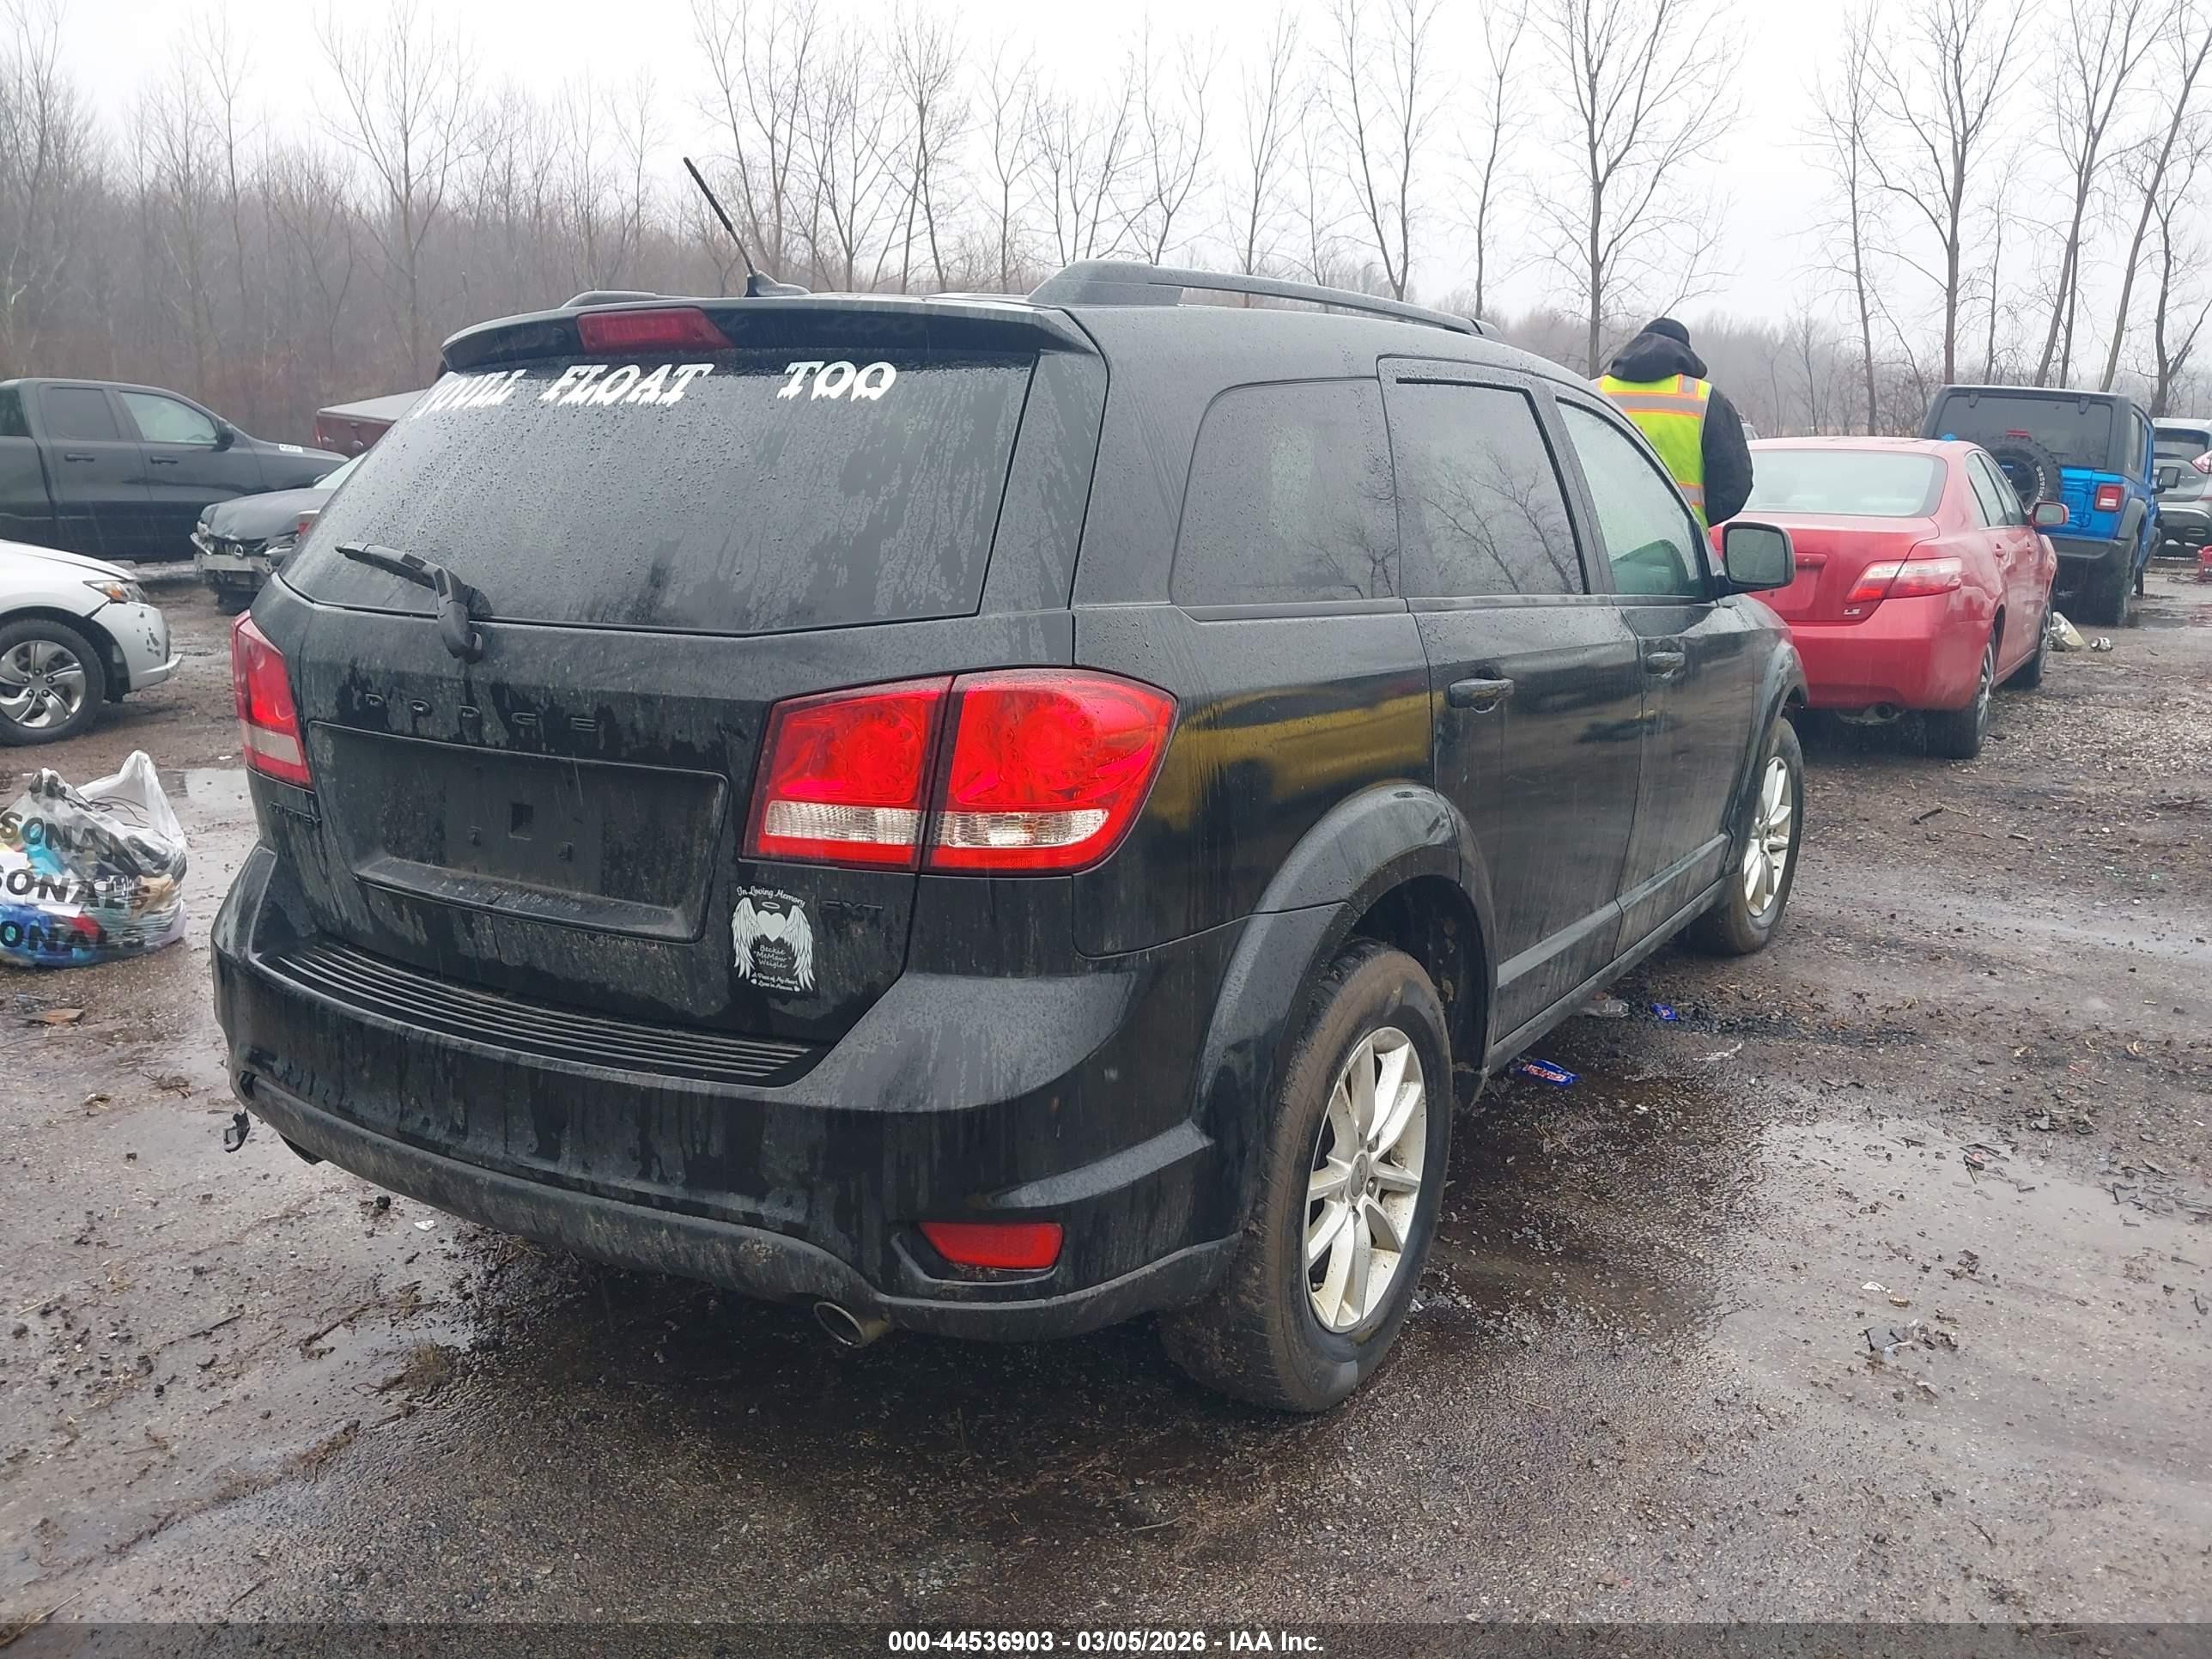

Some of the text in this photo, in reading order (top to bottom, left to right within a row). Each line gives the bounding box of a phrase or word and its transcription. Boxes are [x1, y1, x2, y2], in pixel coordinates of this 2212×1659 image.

[539, 362, 714, 407] FLOAT
[777, 360, 897, 401] TOO
[736, 885, 805, 908] In Loving Memory
